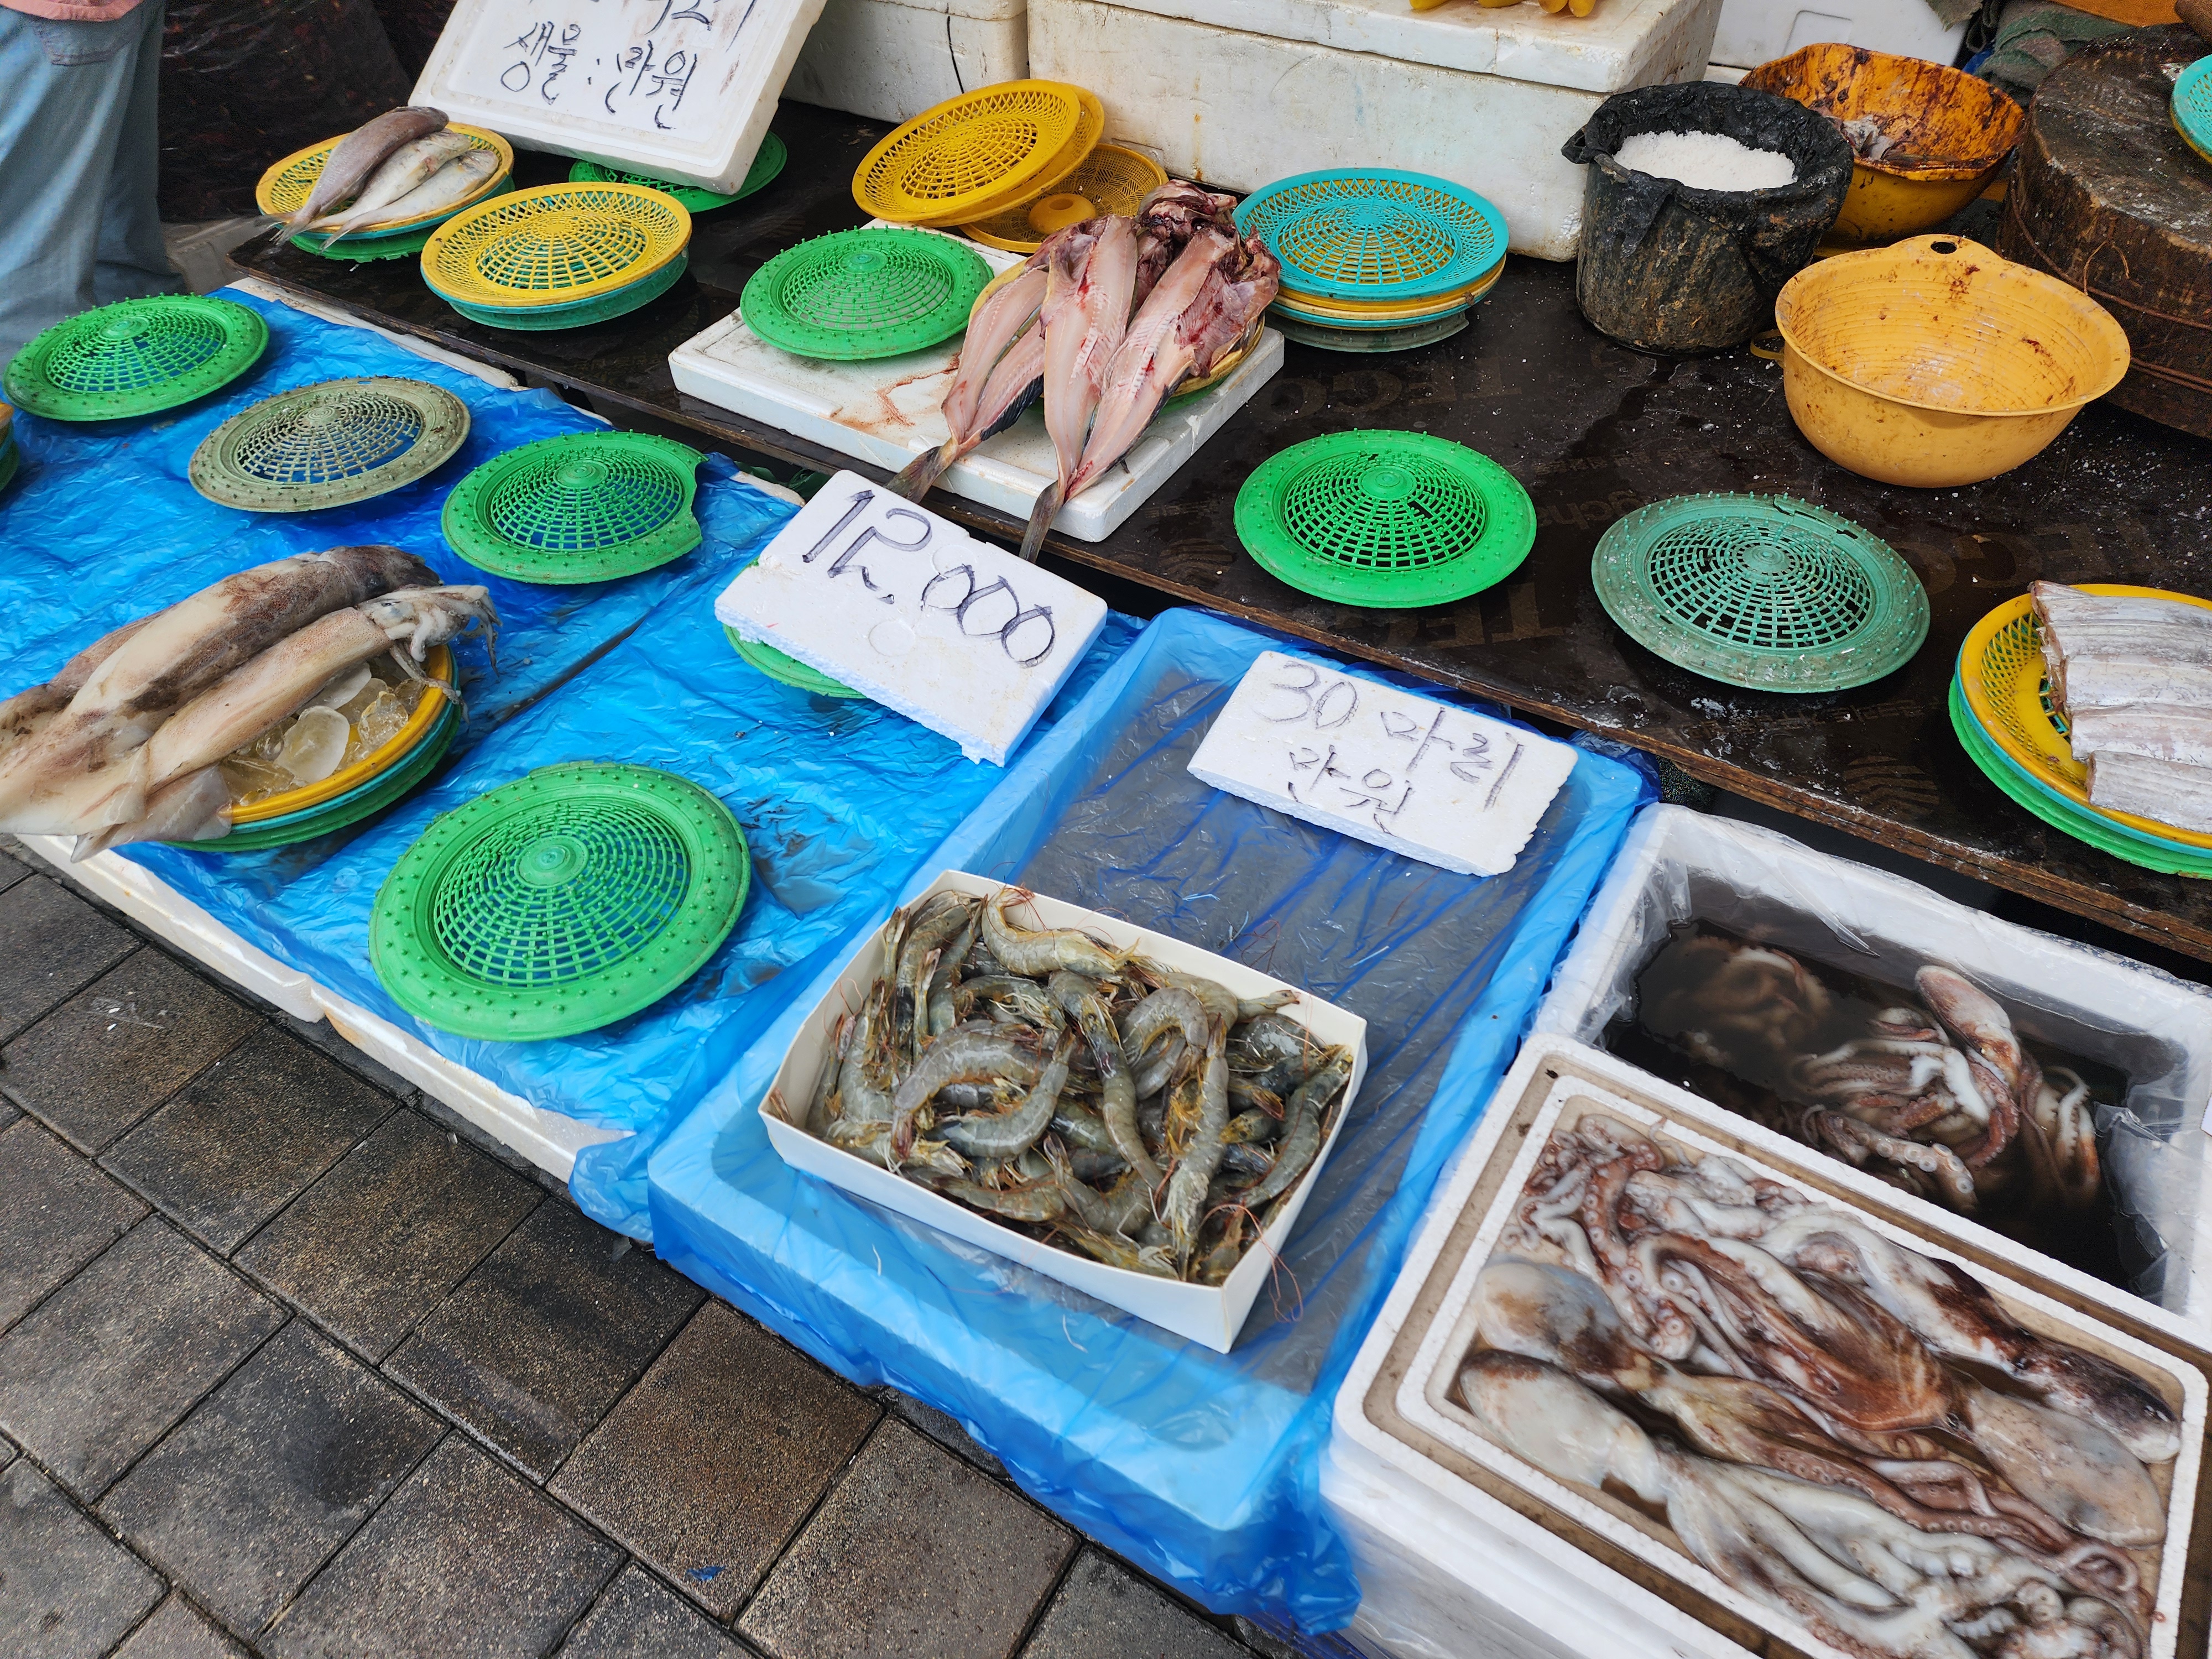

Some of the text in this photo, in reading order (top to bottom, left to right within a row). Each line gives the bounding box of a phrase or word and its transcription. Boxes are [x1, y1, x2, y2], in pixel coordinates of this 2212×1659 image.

[501, 22, 581, 105] 생물
[1255, 661, 1524, 812] 30 마리
[1288, 744, 1416, 838] 만원
